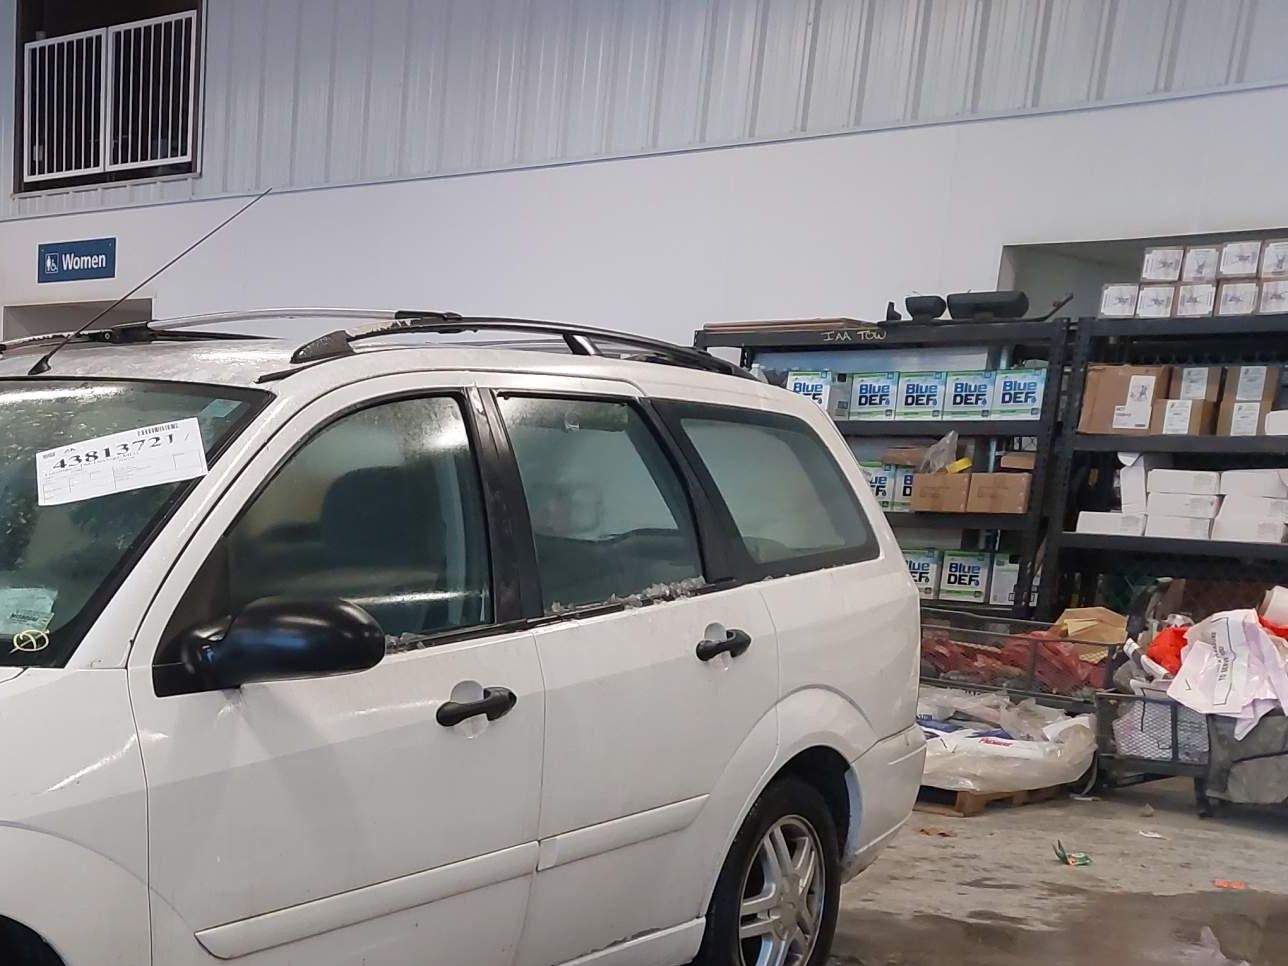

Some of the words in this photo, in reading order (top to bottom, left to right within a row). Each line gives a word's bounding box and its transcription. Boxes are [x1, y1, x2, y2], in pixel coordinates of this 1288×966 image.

[61, 253, 106, 271] Women
[793, 382, 824, 393] Blue
[858, 383, 891, 395] Blue
[905, 383, 938, 395] Blue
[954, 382, 988, 394] Blue
[1002, 380, 1038, 392] Blue
[52, 433, 175, 470] 43813721
[905, 559, 930, 571] lue
[948, 562, 981, 574] Blue
[947, 574, 980, 586] DEF
